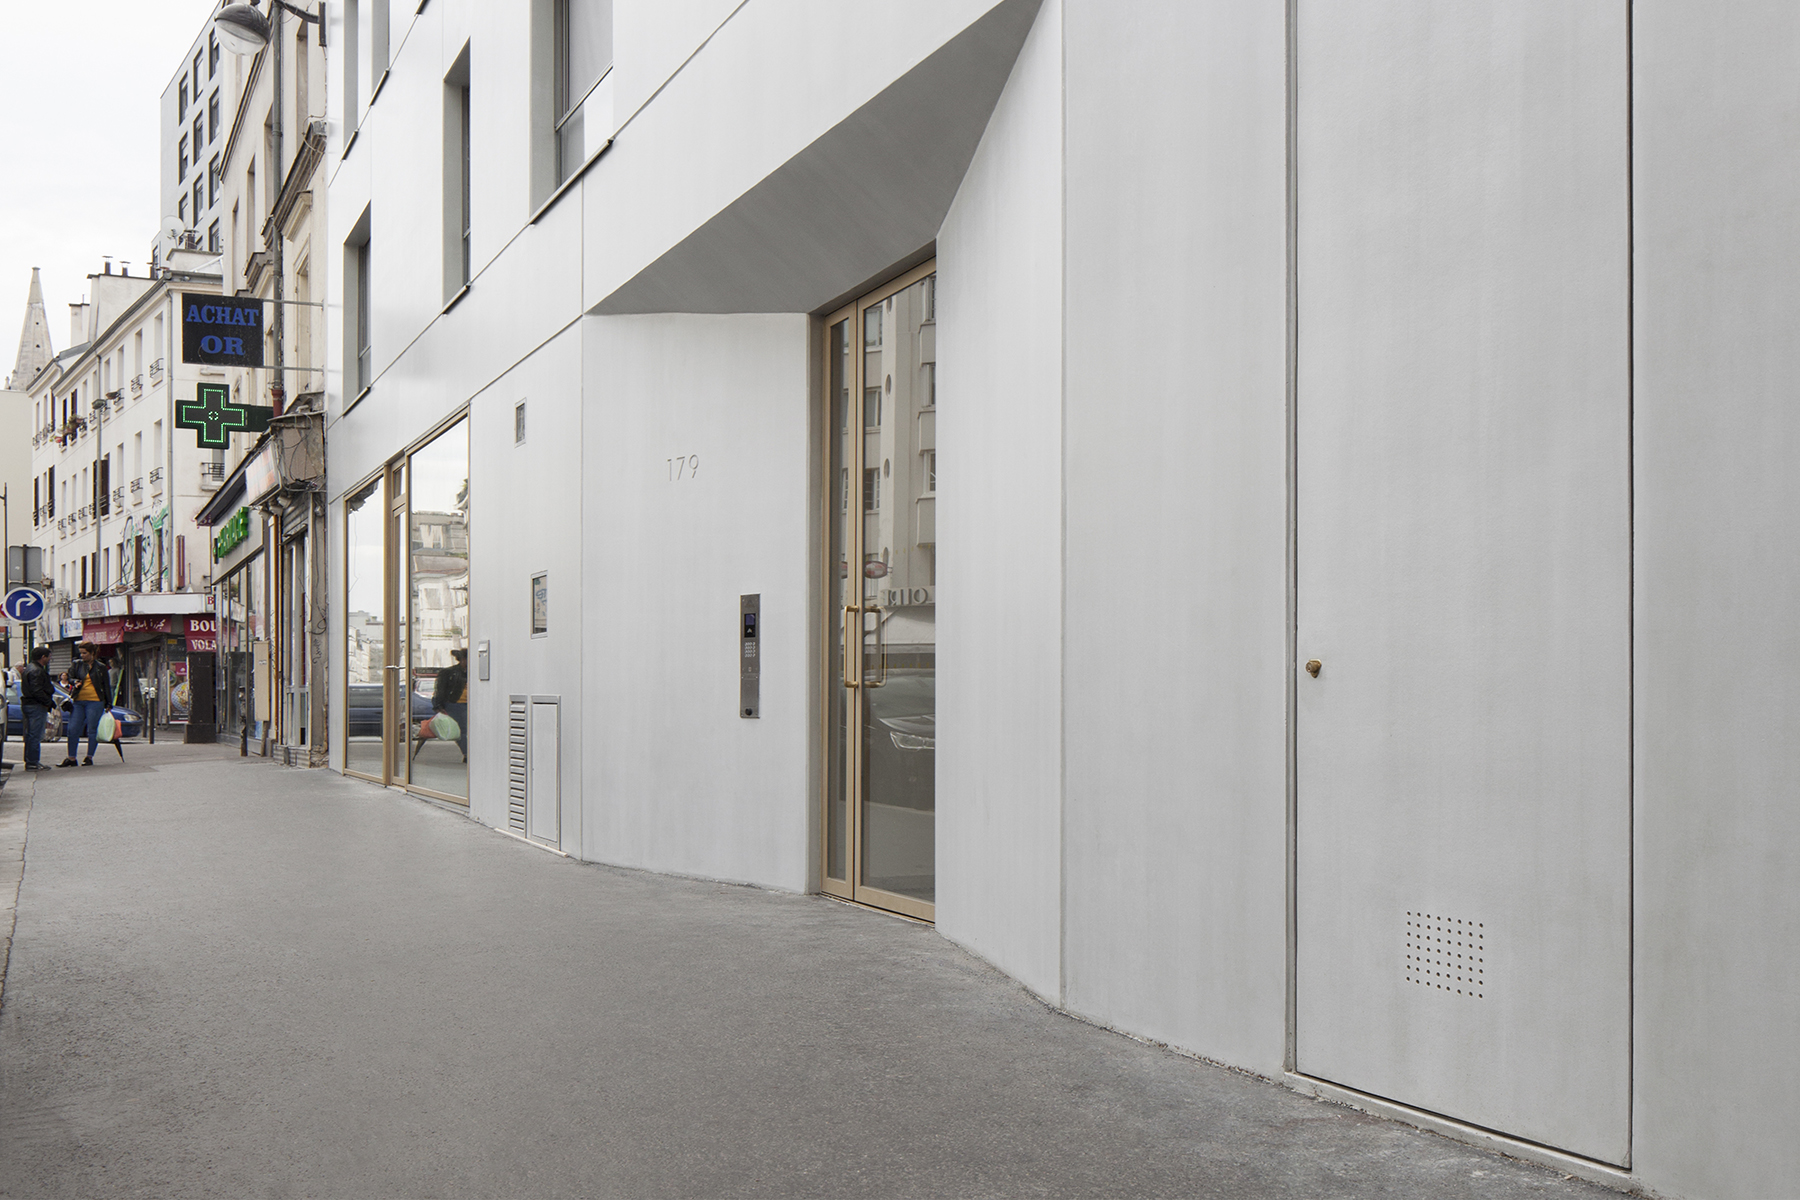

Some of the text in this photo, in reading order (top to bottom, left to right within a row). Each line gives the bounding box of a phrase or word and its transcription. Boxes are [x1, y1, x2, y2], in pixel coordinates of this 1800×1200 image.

[186, 304, 259, 327] ACHAT
[201, 335, 246, 356] OR
[667, 454, 699, 481] 179
